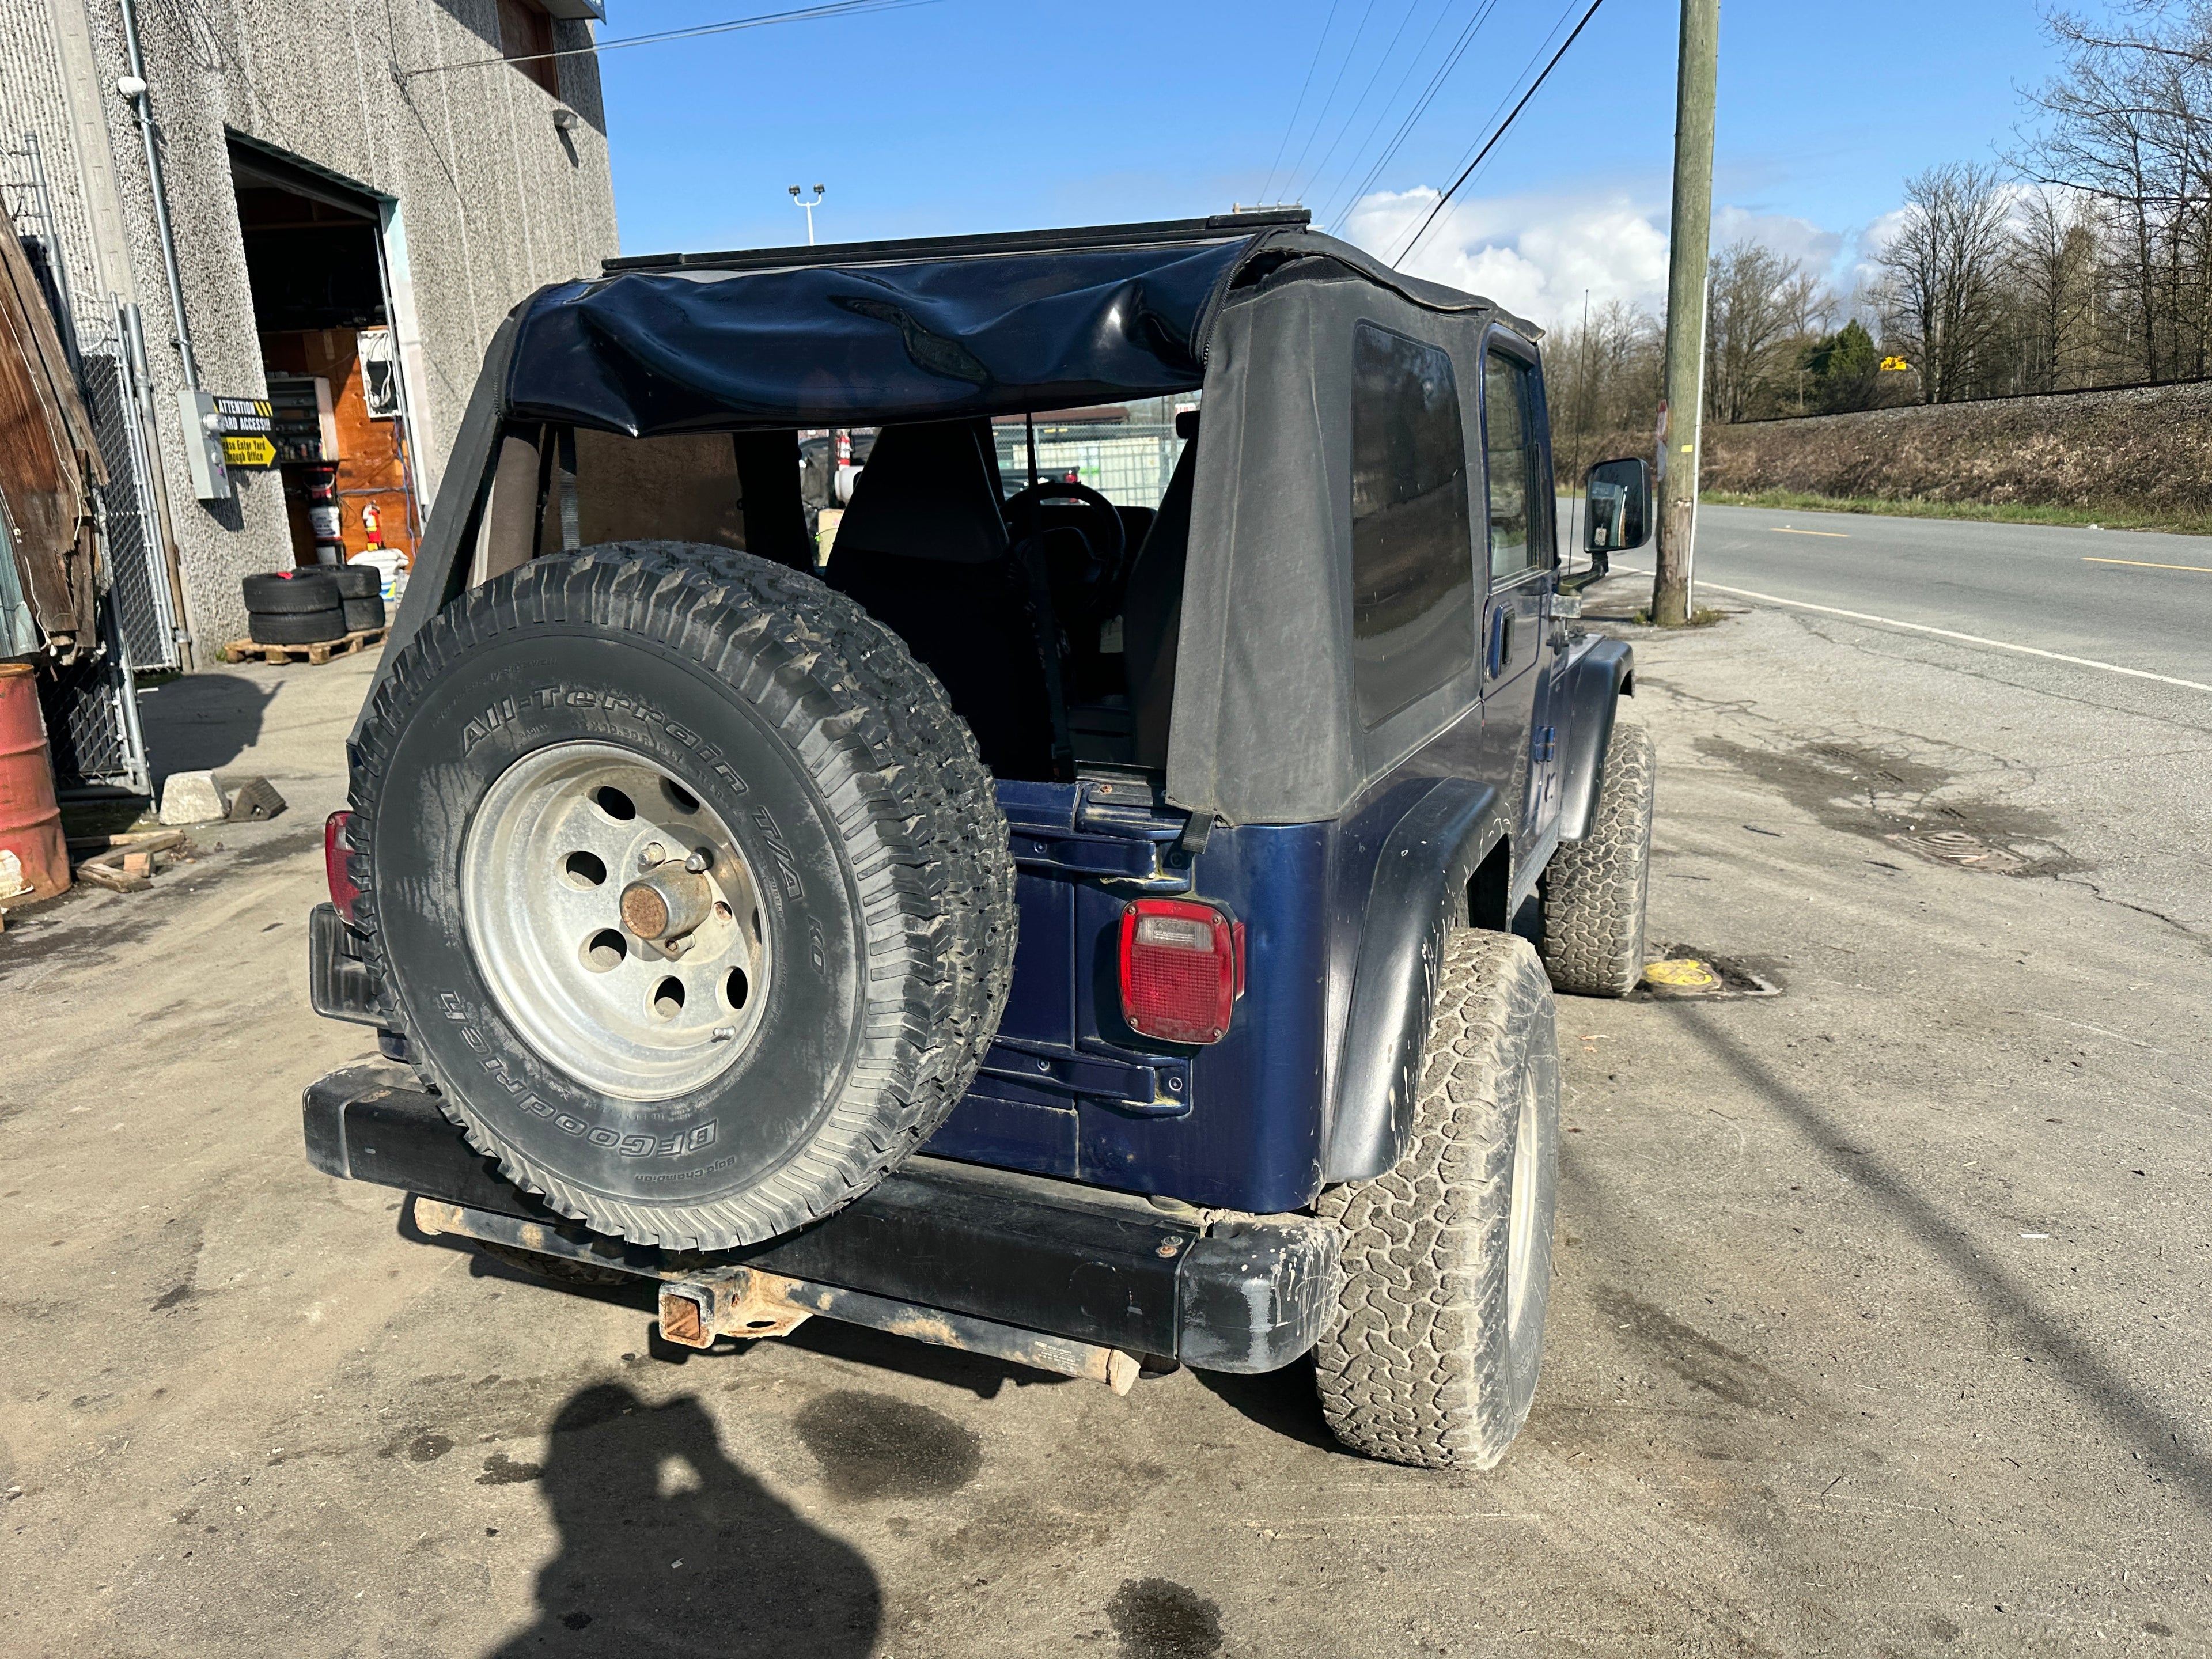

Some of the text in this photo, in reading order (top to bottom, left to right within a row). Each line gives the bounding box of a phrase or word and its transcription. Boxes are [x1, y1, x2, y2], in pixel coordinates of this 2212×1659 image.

[218, 399, 256, 415] ATTENTION
[224, 416, 271, 431] ARD ACCESS!!!
[237, 440, 252, 451] Enter
[253, 439, 266, 451] Yard
[247, 452, 264, 462] Office
[463, 684, 748, 795] All-Terrain
[752, 806, 805, 902] T/A
[808, 915, 824, 975] KO
[440, 990, 718, 1158] BFGoodrich
[635, 1156, 736, 1183] Baja Champion
